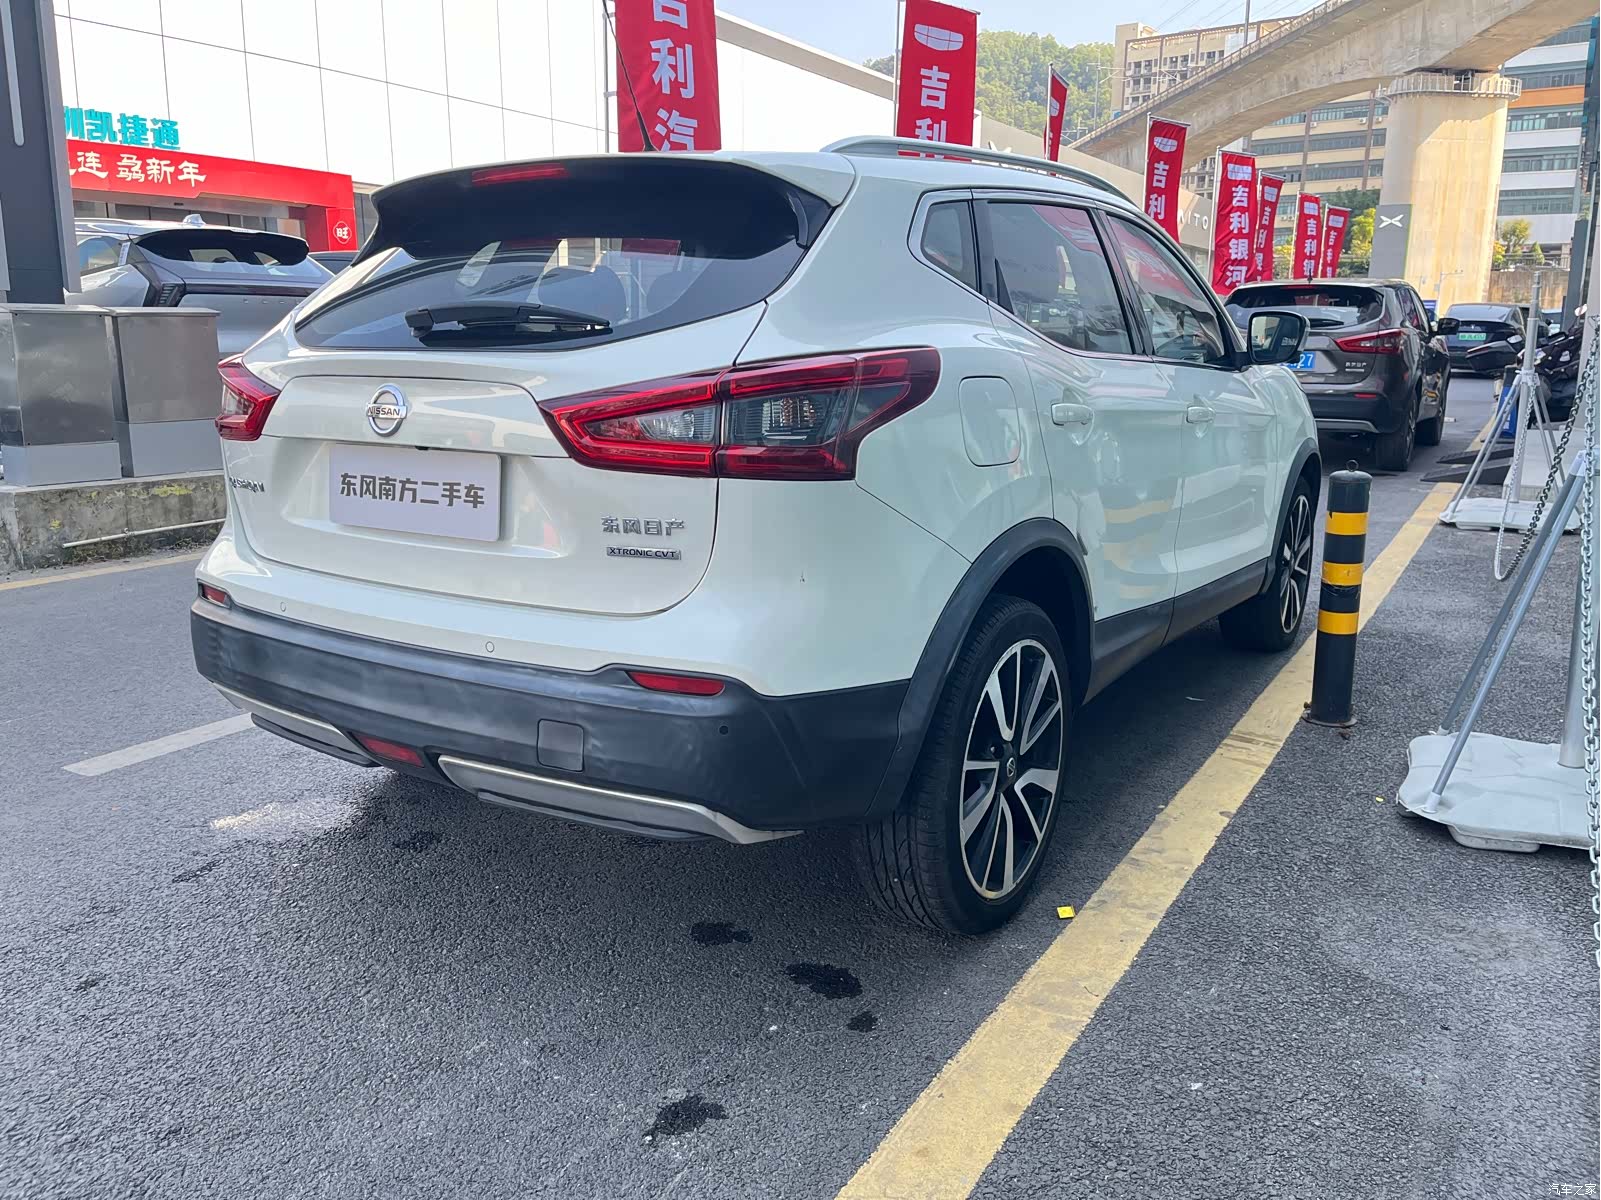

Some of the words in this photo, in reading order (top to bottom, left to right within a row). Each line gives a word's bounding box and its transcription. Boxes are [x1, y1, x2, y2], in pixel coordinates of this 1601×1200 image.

[335, 226, 349, 240] 旺
[1225, 184, 1250, 288] 吉利银河
[366, 405, 401, 417] NISSAN
[340, 472, 485, 508] 东风南方二手车
[601, 515, 685, 537] 东风日产
[609, 547, 653, 557] XTRONIC
[654, 550, 677, 558] CVT
